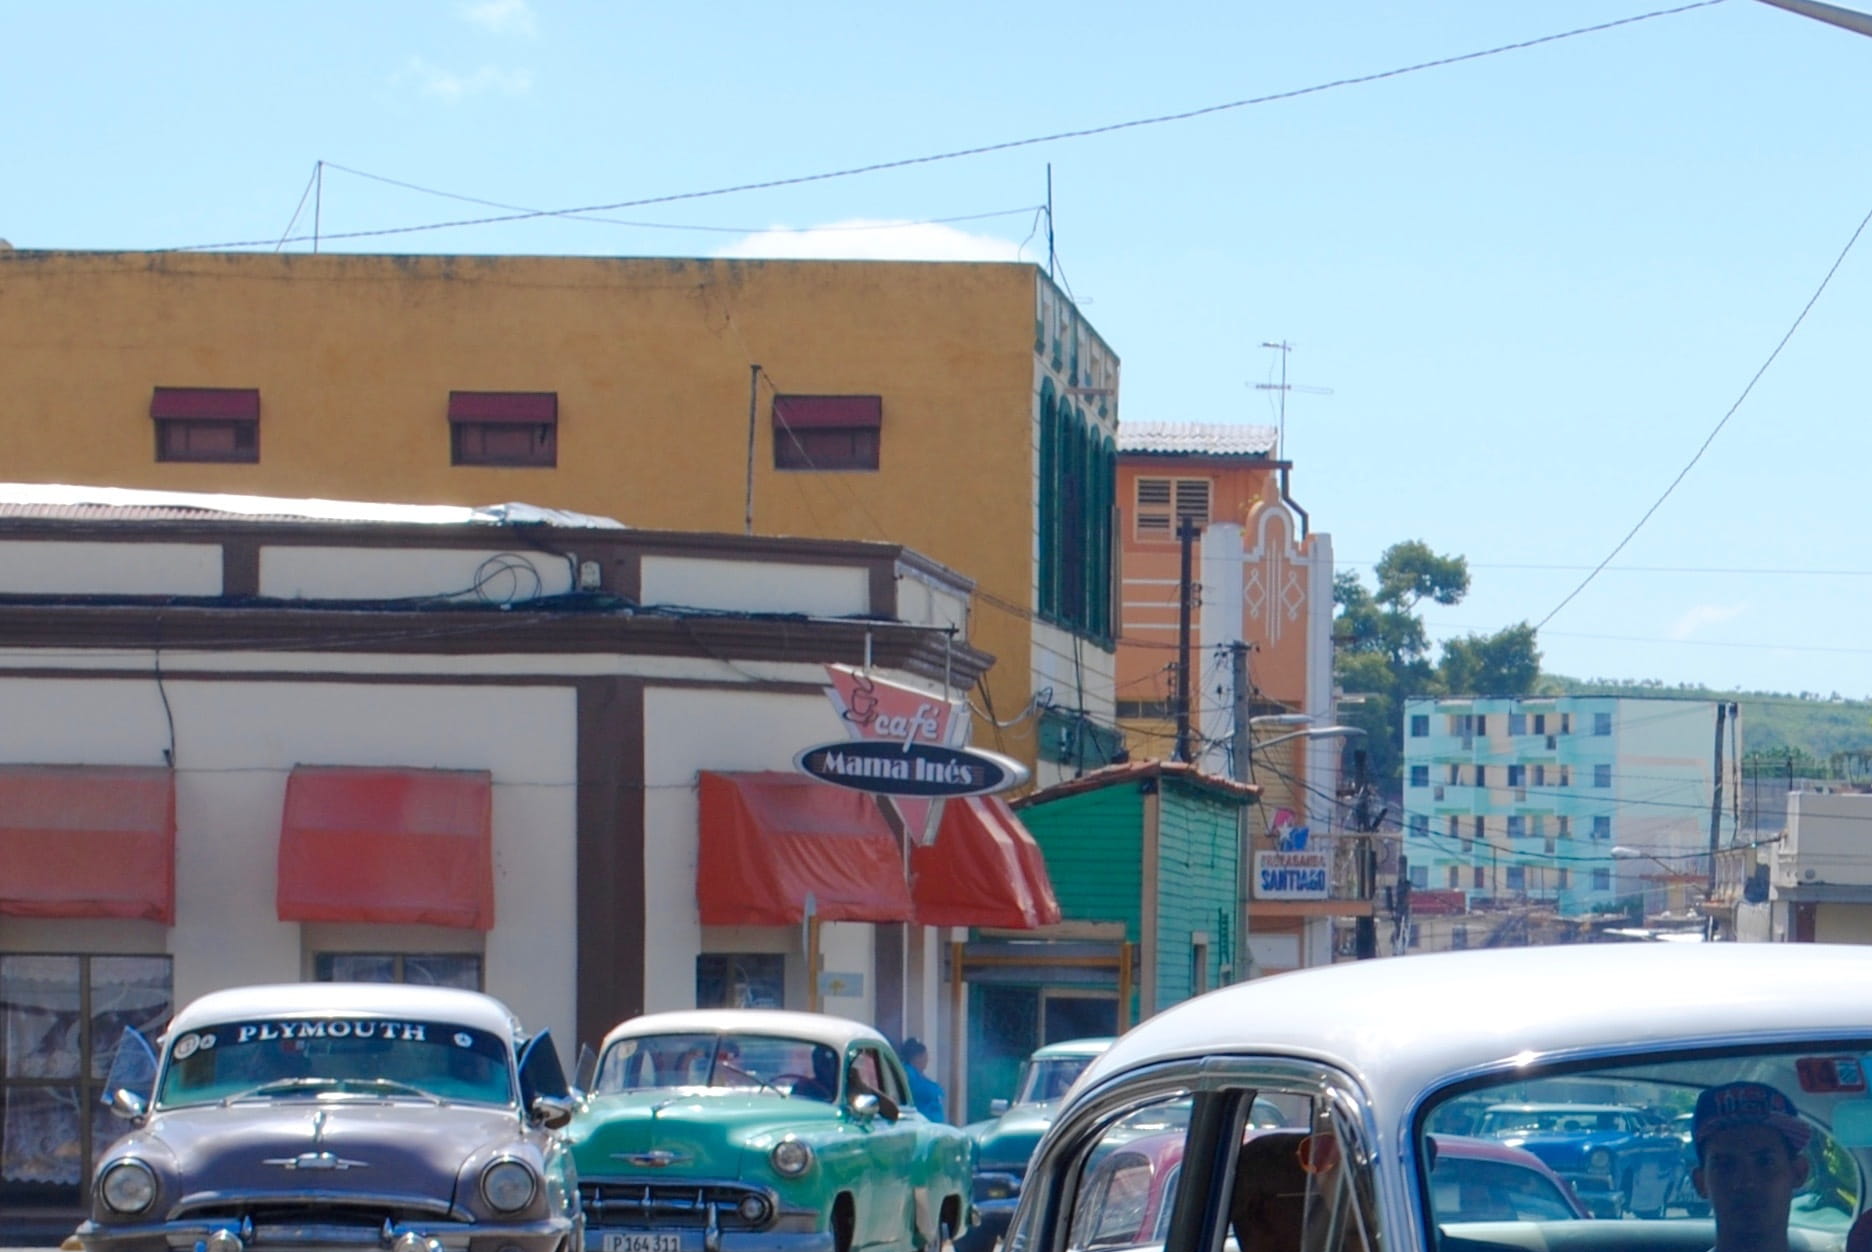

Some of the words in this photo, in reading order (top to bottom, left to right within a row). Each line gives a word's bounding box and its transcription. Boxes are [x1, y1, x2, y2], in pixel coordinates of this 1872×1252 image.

[874, 703, 940, 753] café
[822, 751, 909, 782] Mama
[915, 756, 973, 786] Inés
[1261, 868, 1326, 892] SANTIAGO
[237, 1021, 426, 1042] PLYMOUTH
